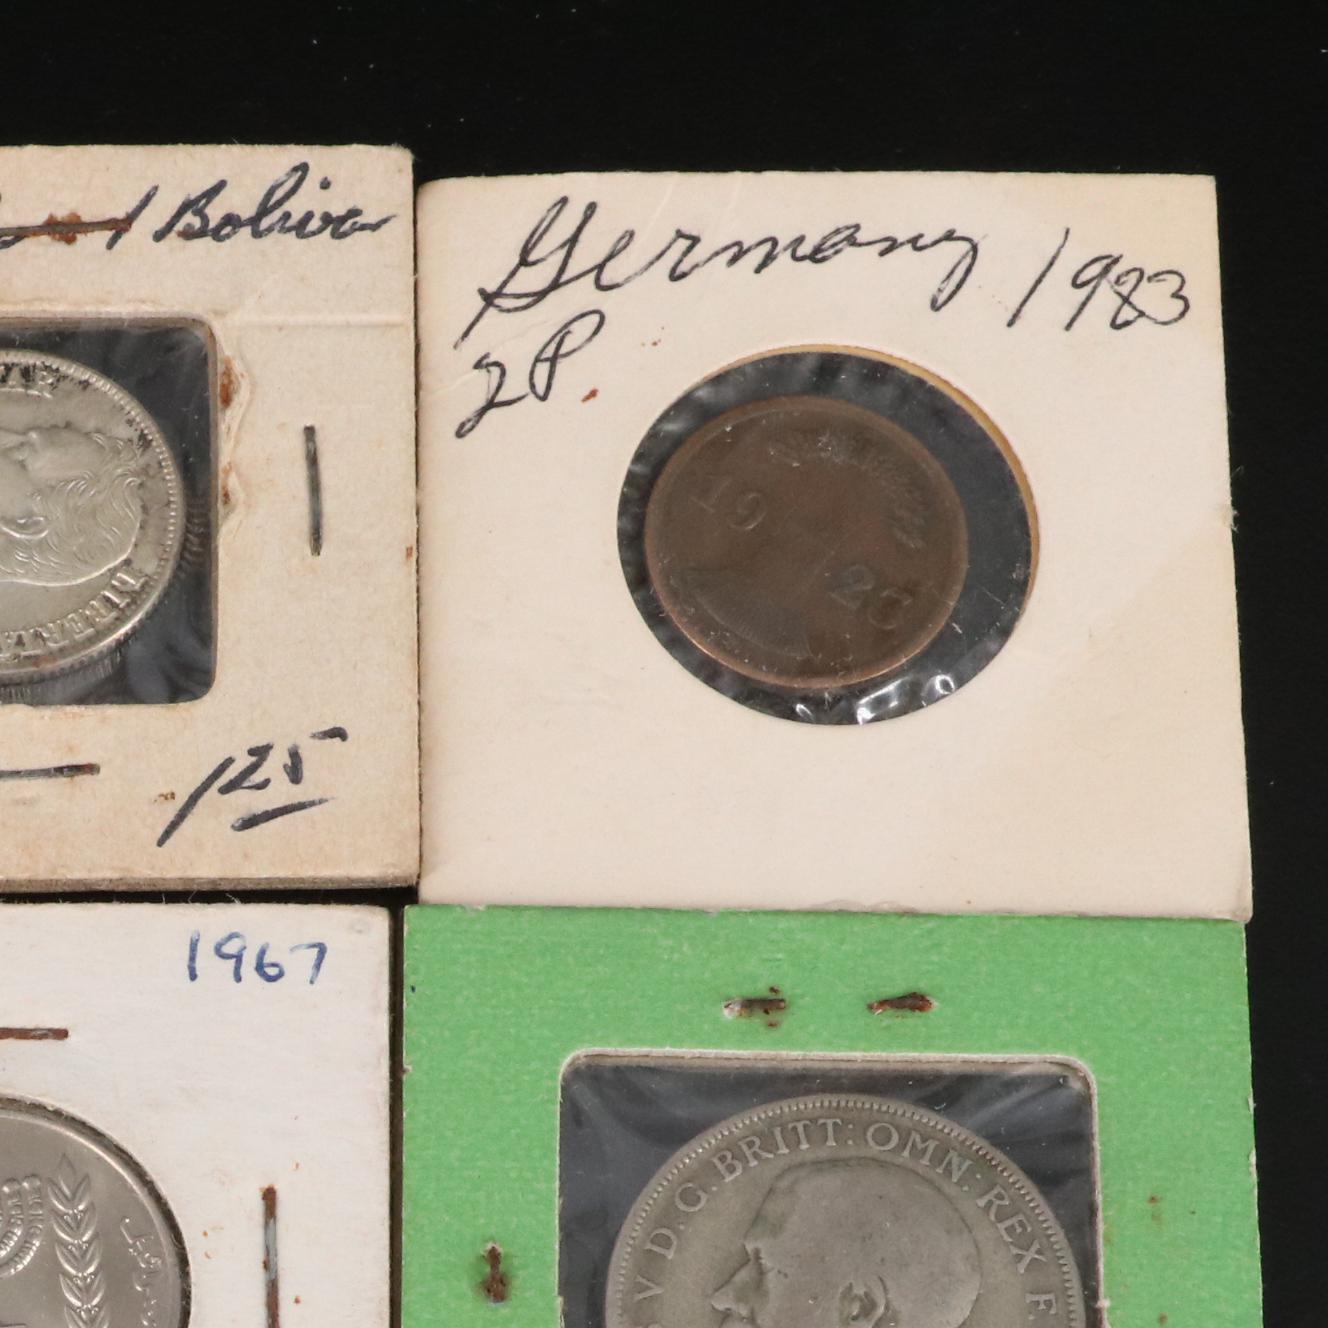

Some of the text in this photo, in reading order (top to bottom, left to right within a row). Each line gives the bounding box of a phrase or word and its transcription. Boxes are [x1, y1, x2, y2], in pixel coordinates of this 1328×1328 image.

[453, 195, 1193, 350] Germany 1983
[185, 931, 329, 985] 1967
[976, 1183, 1047, 1274] REX
